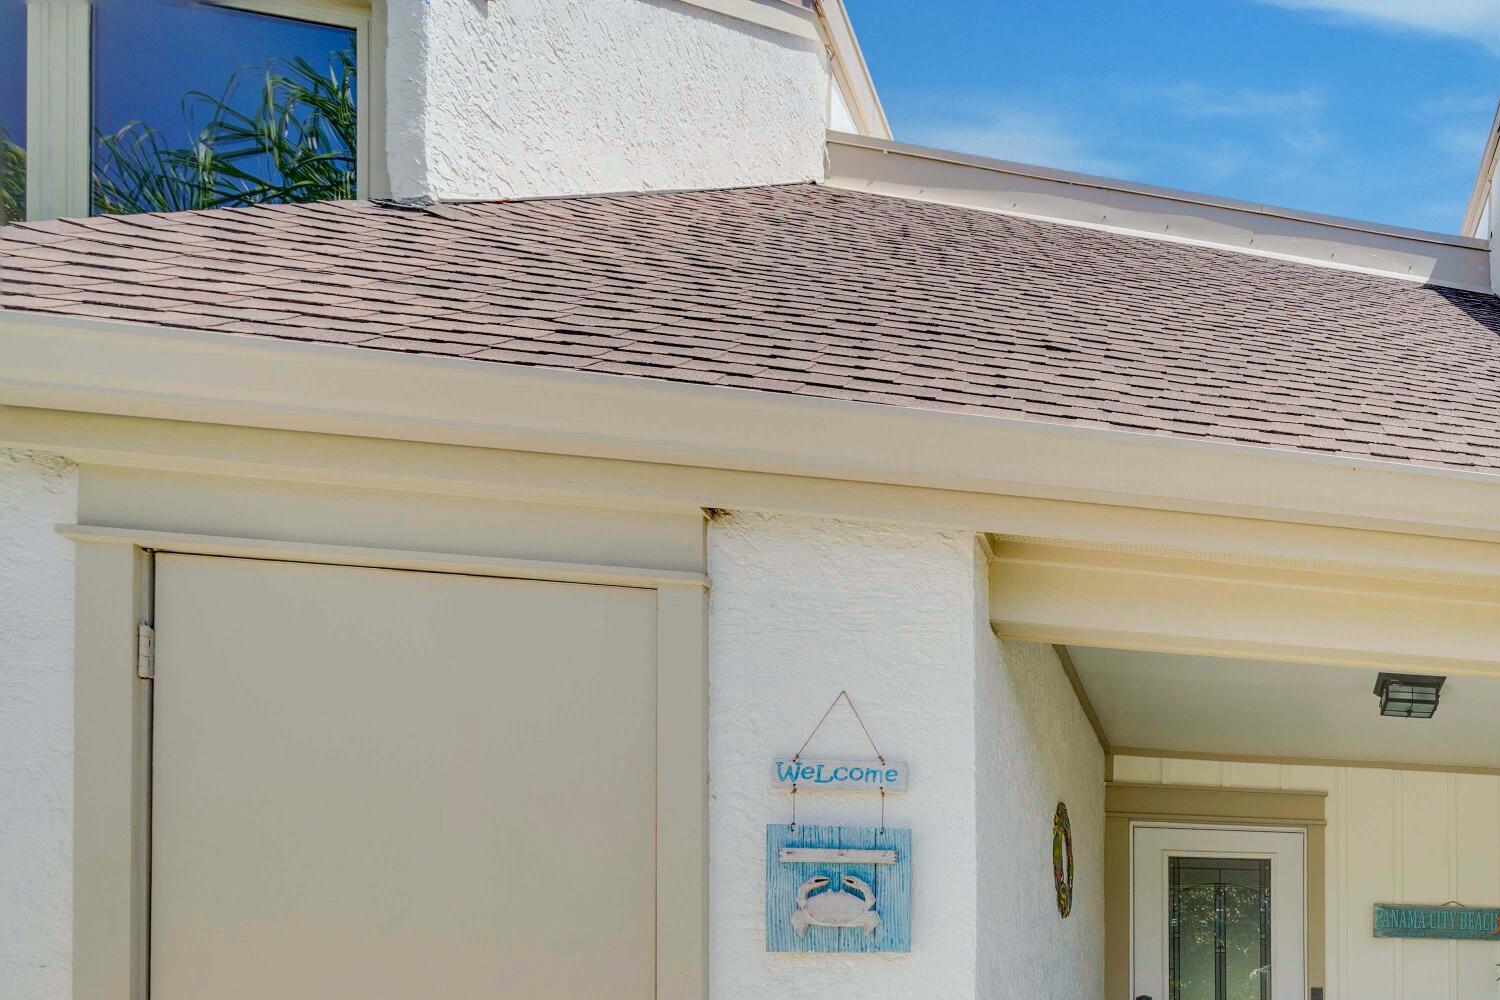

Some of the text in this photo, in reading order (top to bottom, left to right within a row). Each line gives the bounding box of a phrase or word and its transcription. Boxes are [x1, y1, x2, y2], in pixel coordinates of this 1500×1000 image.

[1375, 907, 1498, 931] PANAMA CITY BEACH
